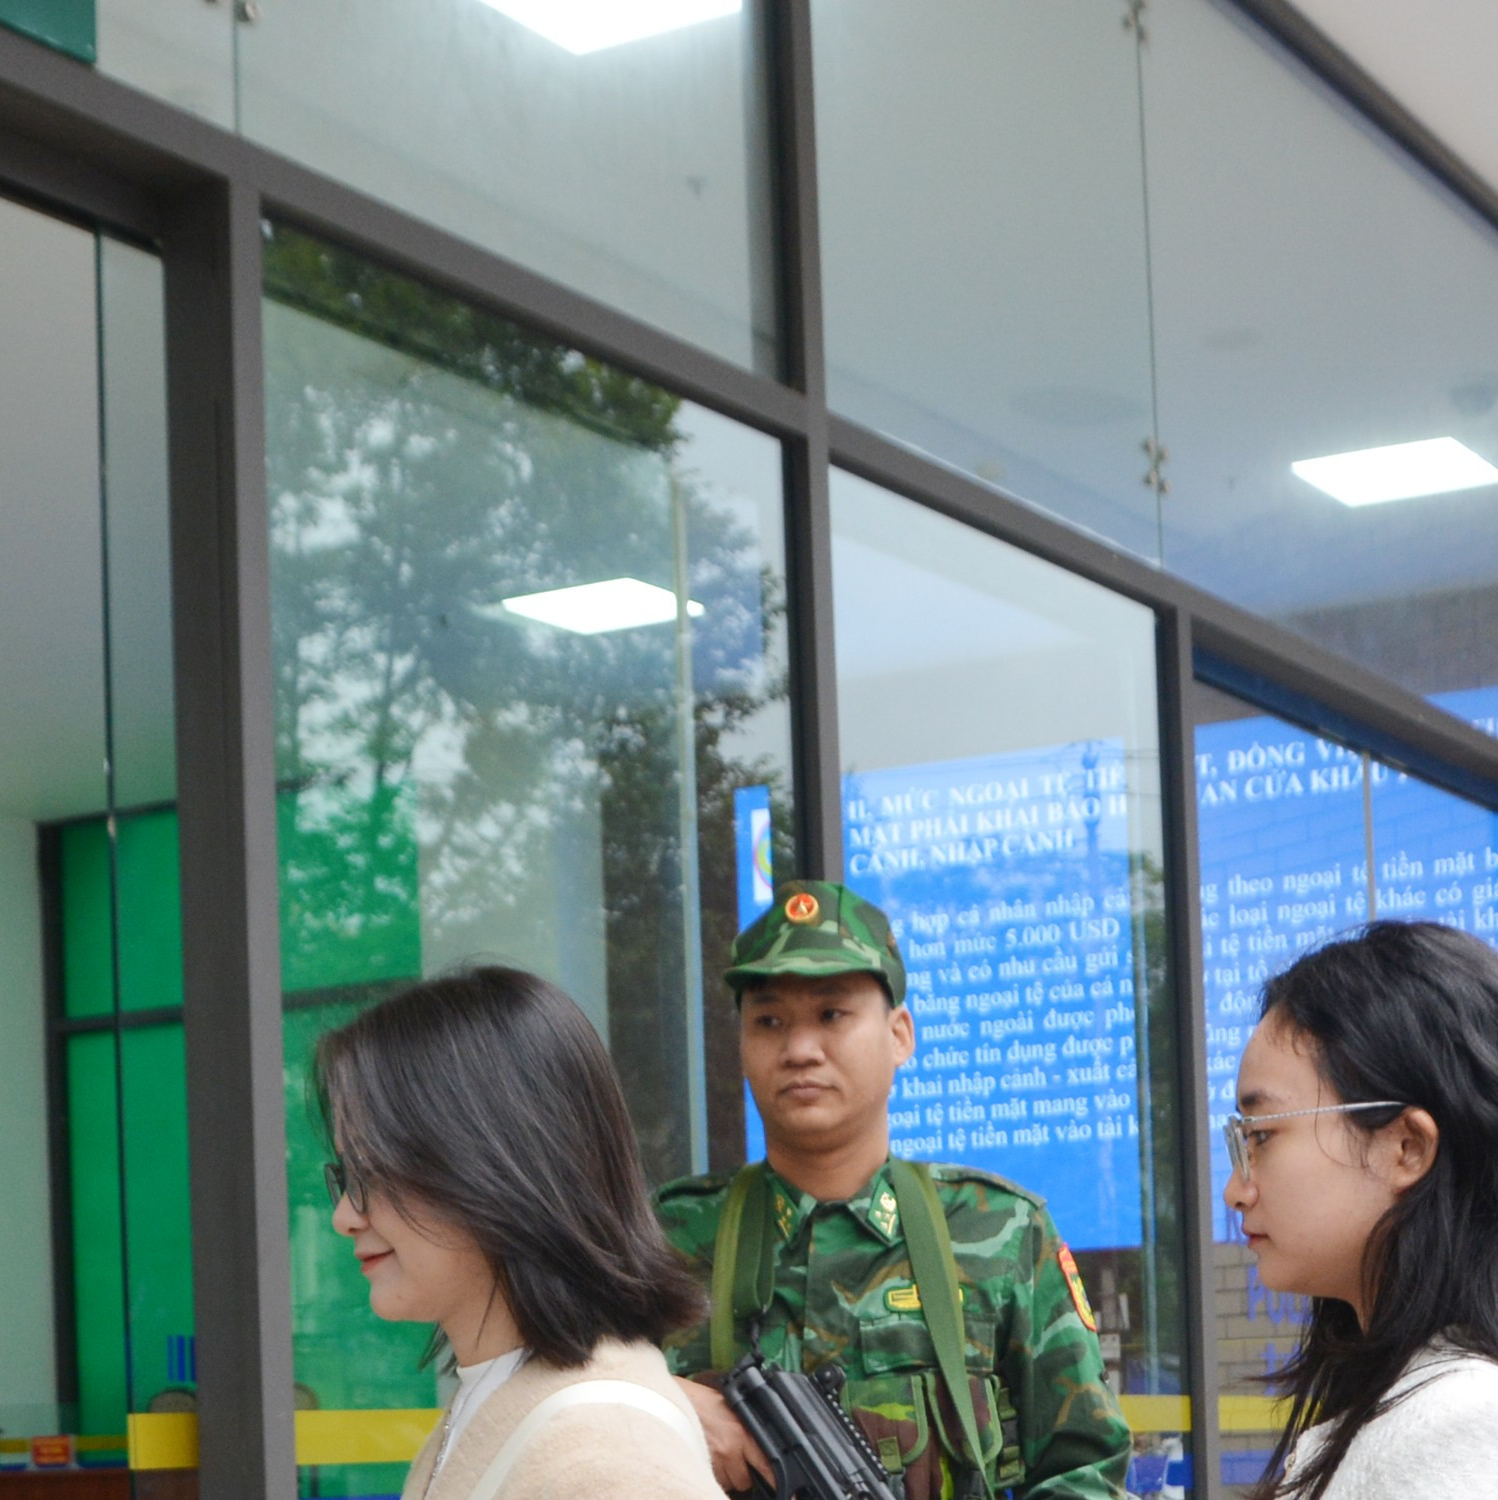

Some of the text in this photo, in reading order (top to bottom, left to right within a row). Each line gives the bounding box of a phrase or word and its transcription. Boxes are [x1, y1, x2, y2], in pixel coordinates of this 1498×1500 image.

[881, 785, 940, 817] MỨC
[1083, 760, 1124, 790] TIỀ
[1227, 738, 1305, 772] ĐỒNG
[976, 803, 1040, 834] KHAI
[1244, 767, 1304, 801] CỬA
[989, 898, 1036, 922] nhân
[1045, 892, 1095, 919] nhập
[1228, 874, 1273, 898] theo
[1282, 863, 1342, 895] ngoại
[1383, 851, 1423, 881] tiền
[1435, 849, 1476, 877] mặt
[1005, 924, 1061, 949] 5.000
[1069, 917, 1121, 943] USD
[1229, 900, 1268, 928] loại
[1278, 892, 1337, 924] ngoại
[1375, 885, 1426, 910] khác
[1435, 880, 1462, 905] có
[967, 958, 993, 981] có
[1221, 931, 1241, 958] tệ
[1248, 924, 1287, 951] tiền
[965, 984, 1020, 1012] ngoại
[1025, 980, 1044, 1004] tệ
[980, 1013, 1034, 1043] ngoài
[1043, 1005, 1094, 1031] được
[922, 1046, 970, 1071] chức
[975, 1043, 1001, 1065] tín
[1006, 1038, 1057, 1067] dụng
[1061, 1034, 1114, 1059] được
[901, 1074, 942, 1099] khai
[948, 1069, 996, 1099] nhập
[1001, 1064, 1047, 1090] cảnh
[1066, 1055, 1111, 1085] xuất
[926, 1101, 944, 1127] tệ
[949, 1095, 986, 1122] tiền
[991, 1096, 1028, 1121] mặt
[1033, 1095, 1088, 1118] mang
[1095, 1088, 1131, 1111] vào
[890, 1130, 942, 1157] ngoại
[948, 1128, 966, 1152] tệ
[972, 1121, 1008, 1148] tiền
[1013, 1122, 1050, 1147] mặt
[1055, 1118, 1092, 1141] vào
[1097, 1114, 1123, 1138] tài
